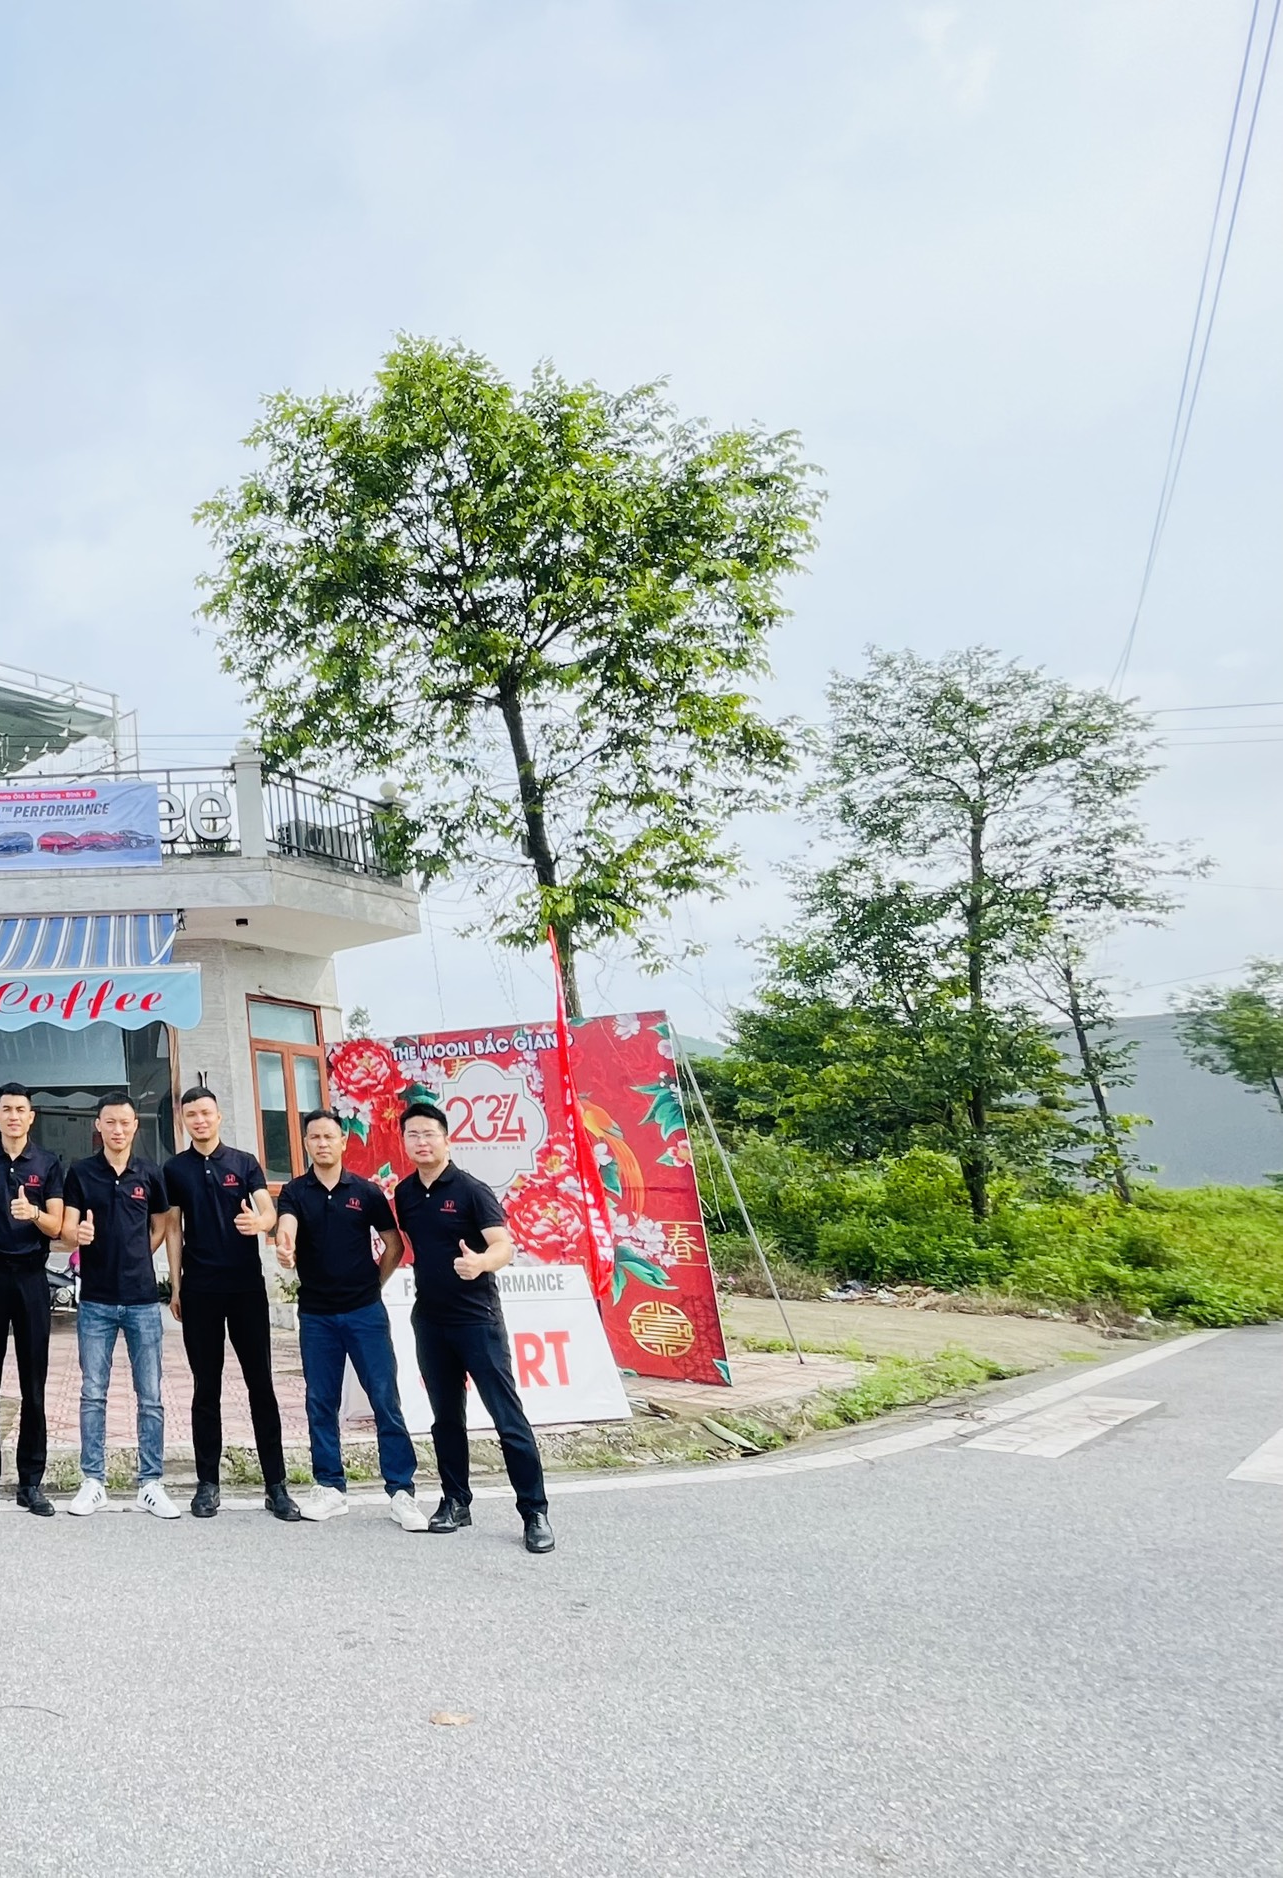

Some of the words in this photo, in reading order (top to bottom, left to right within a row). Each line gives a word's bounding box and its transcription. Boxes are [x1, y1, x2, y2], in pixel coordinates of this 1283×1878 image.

[13, 803, 111, 818] PERFORMANCE
[391, 1044, 418, 1062] THE
[419, 1041, 471, 1060] MOON
[473, 1032, 510, 1055] BẮC
